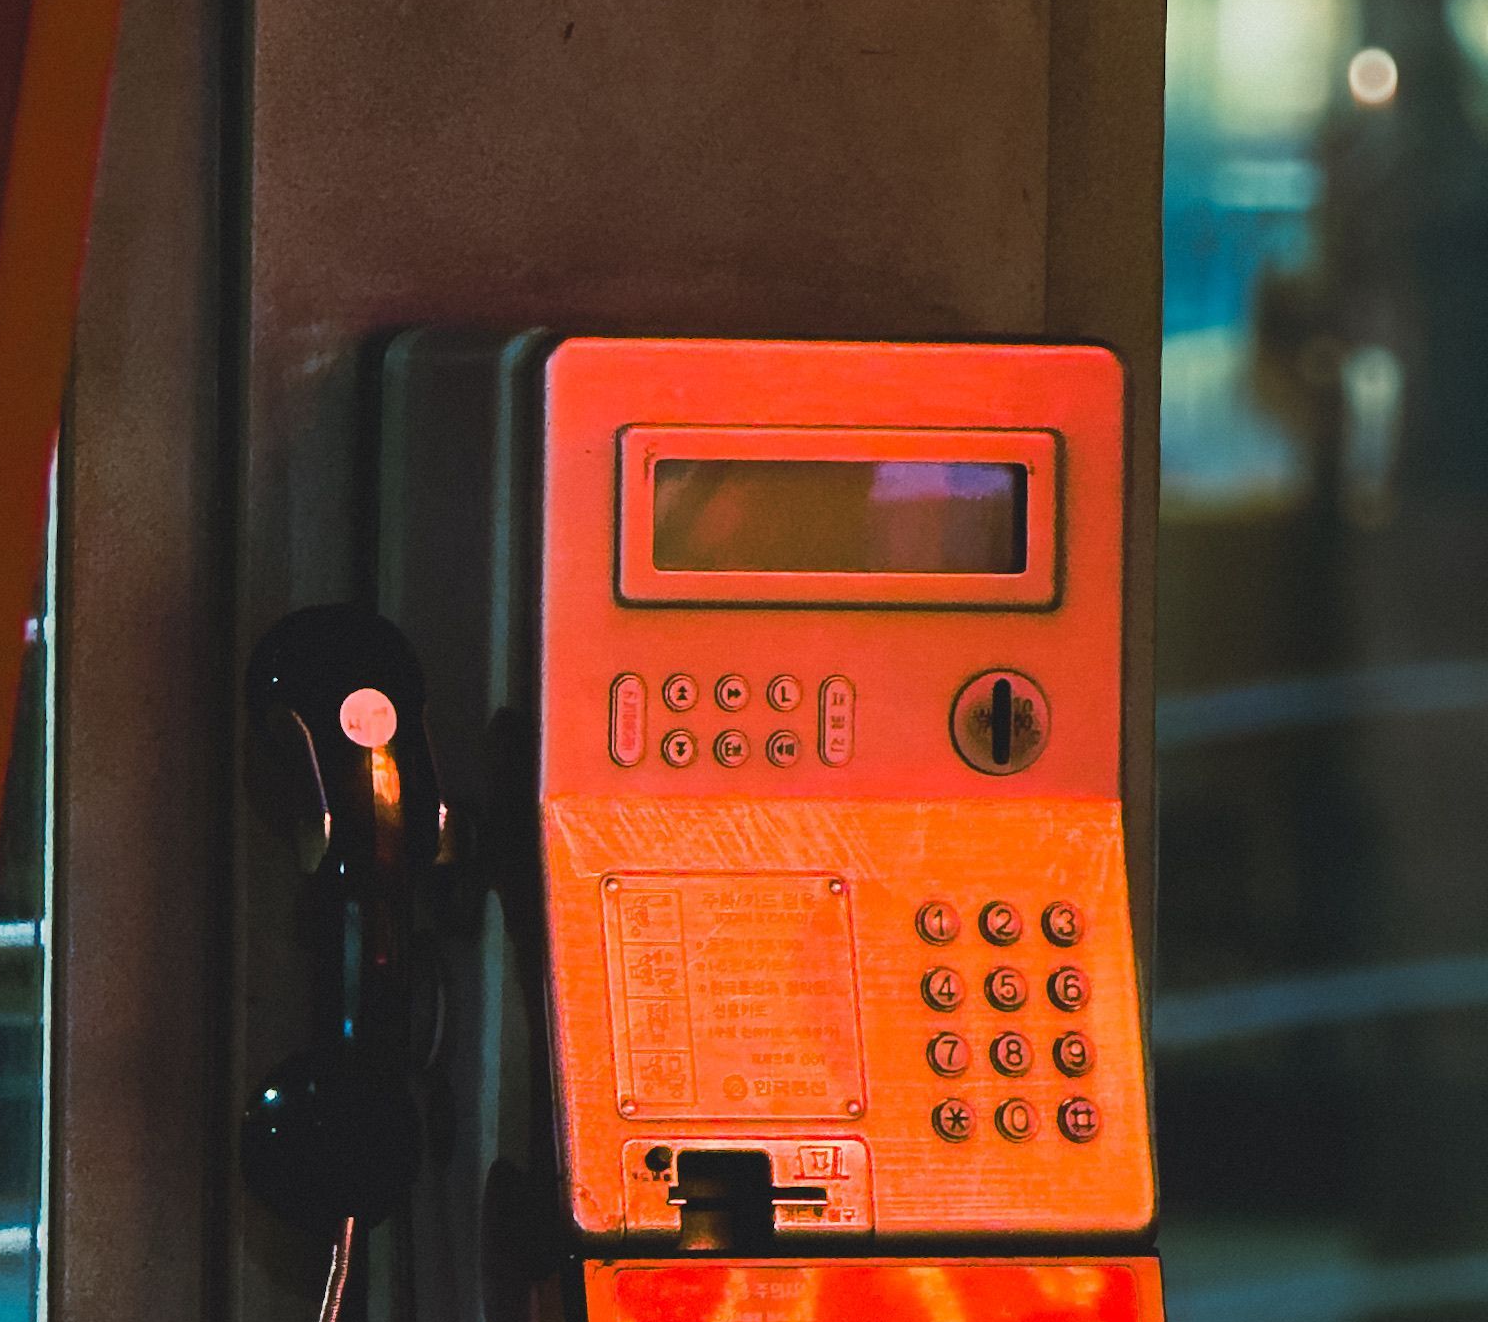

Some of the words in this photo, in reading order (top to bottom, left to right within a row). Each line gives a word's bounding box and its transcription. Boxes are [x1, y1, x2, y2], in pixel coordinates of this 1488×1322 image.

[932, 909, 944, 937] 1
[994, 908, 1012, 936] 2
[1059, 909, 1076, 937] 3
[937, 974, 955, 1001] 4
[1000, 975, 1017, 1003] 5
[1063, 976, 1082, 1003] 6
[942, 1040, 958, 1066] 7
[1005, 1039, 1023, 1067] 8
[1067, 1040, 1086, 1067] 9
[1013, 1106, 1029, 1132] 0
